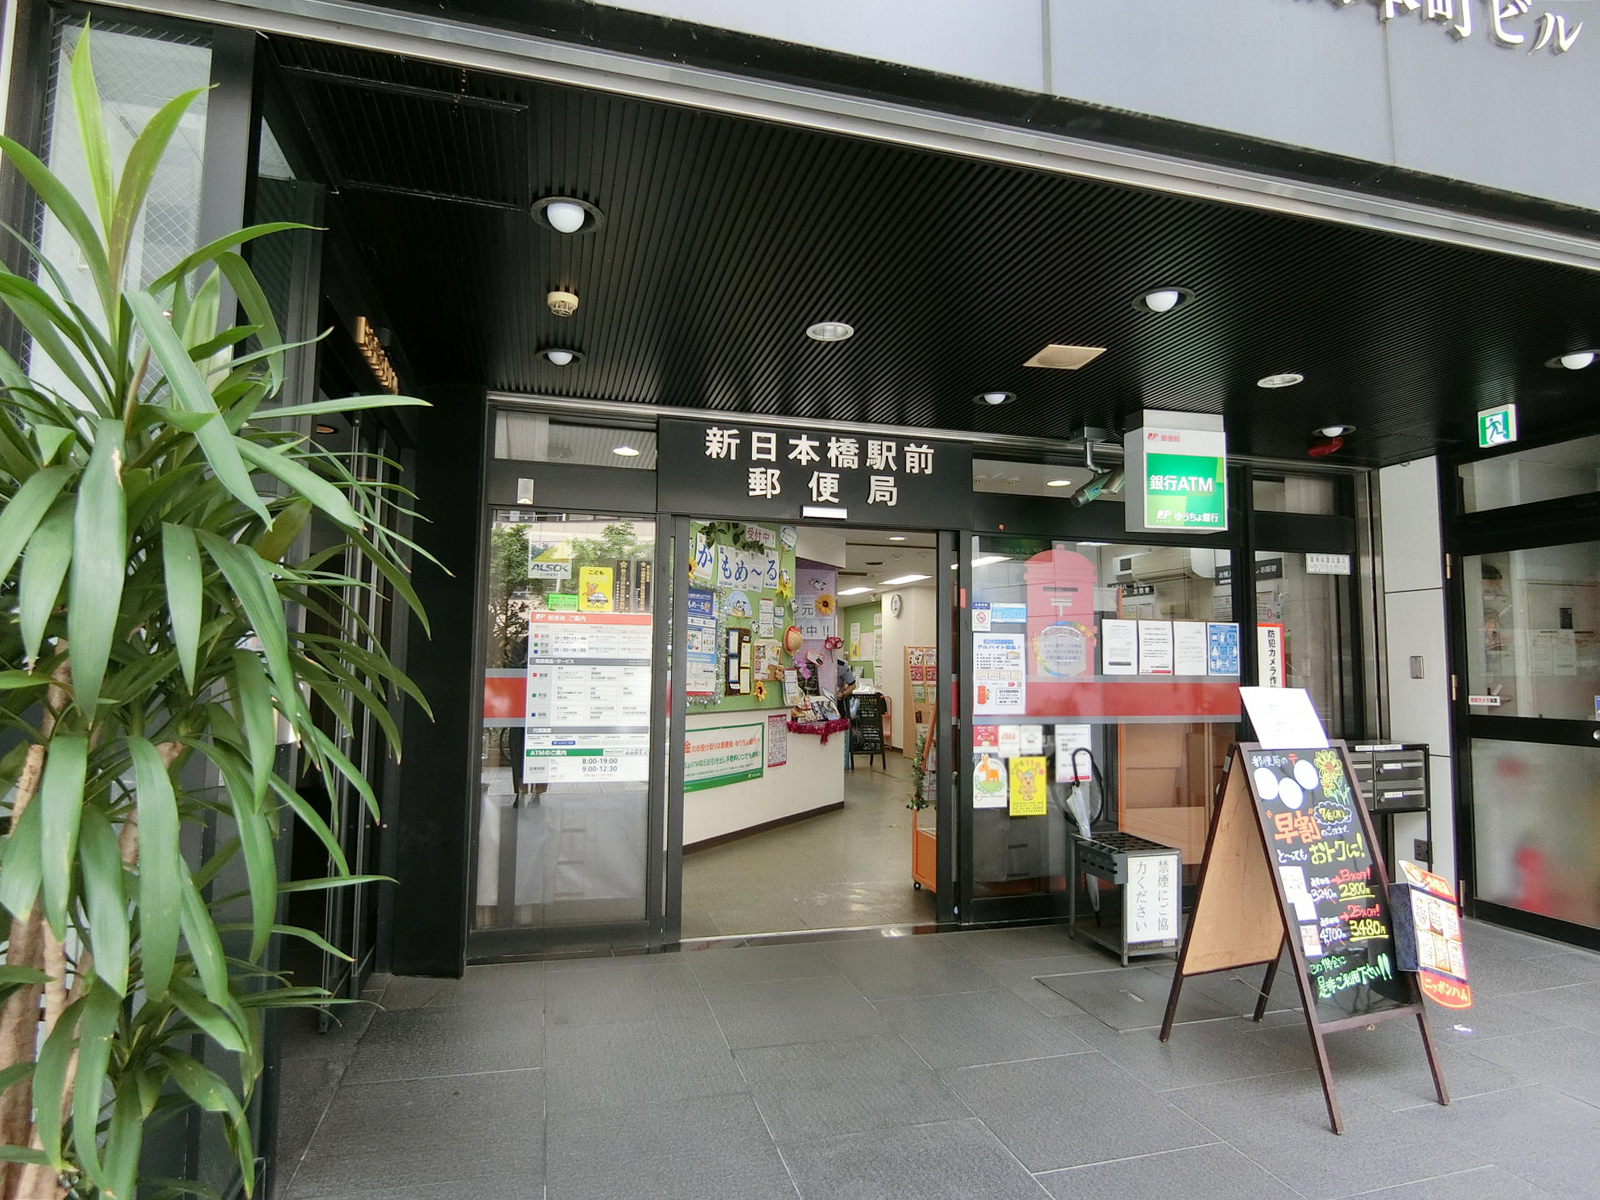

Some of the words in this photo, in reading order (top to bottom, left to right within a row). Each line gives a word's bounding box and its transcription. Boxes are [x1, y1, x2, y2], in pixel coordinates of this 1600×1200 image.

[704, 427, 935, 475] 新日本橋駅前
[748, 467, 899, 507] 郵便局
[1149, 475, 1213, 492] 銀行ATM
[1174, 512, 1219, 523] ゆうちょ銀行
[530, 563, 570, 573] ALSOK
[1267, 629, 1277, 687] 防犯カメラ作
[582, 765, 618, 773] 9:00-12:30
[1136, 861, 1148, 931] 力ください
[1424, 979, 1468, 1002] ニッポンハム
